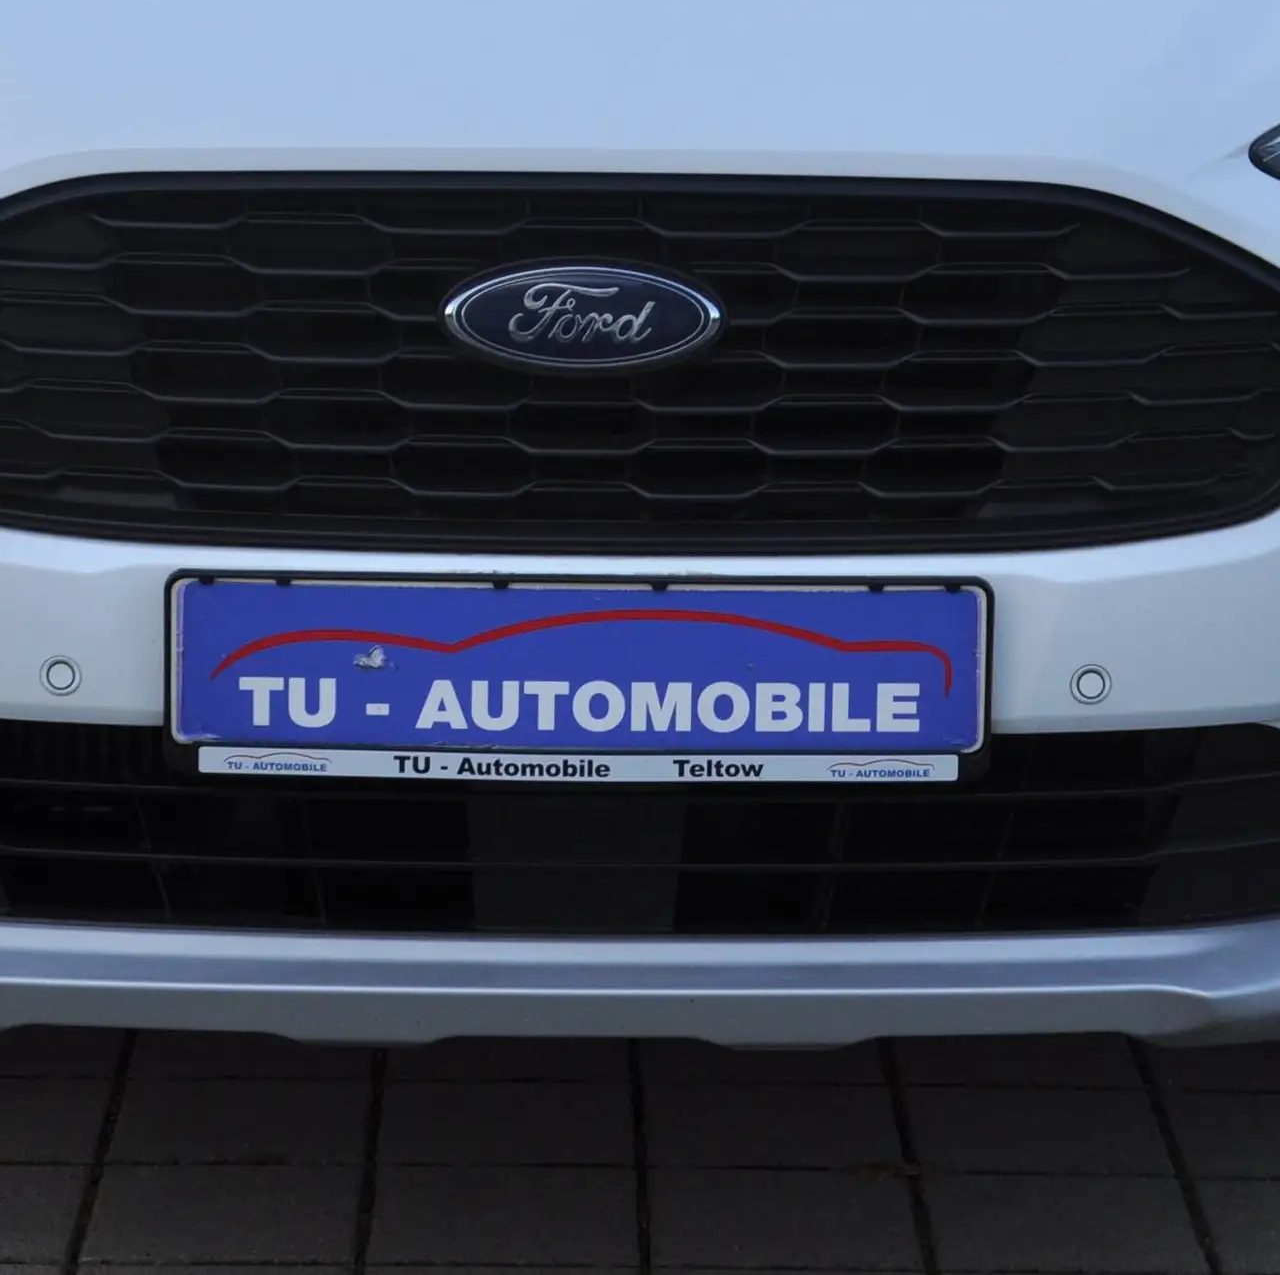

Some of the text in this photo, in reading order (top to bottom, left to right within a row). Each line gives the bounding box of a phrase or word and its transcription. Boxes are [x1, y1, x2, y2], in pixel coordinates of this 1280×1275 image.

[508, 282, 656, 344] Ford
[239, 676, 920, 733] TU - AUTOMOBILE
[226, 760, 243, 771] TU
[252, 761, 327, 773] AUTOMOBILE
[393, 755, 431, 775] TU
[456, 756, 611, 778] Automobile
[673, 759, 764, 778] Teltow
[830, 769, 847, 778] TU
[855, 768, 931, 779] AUTOMOBILE
